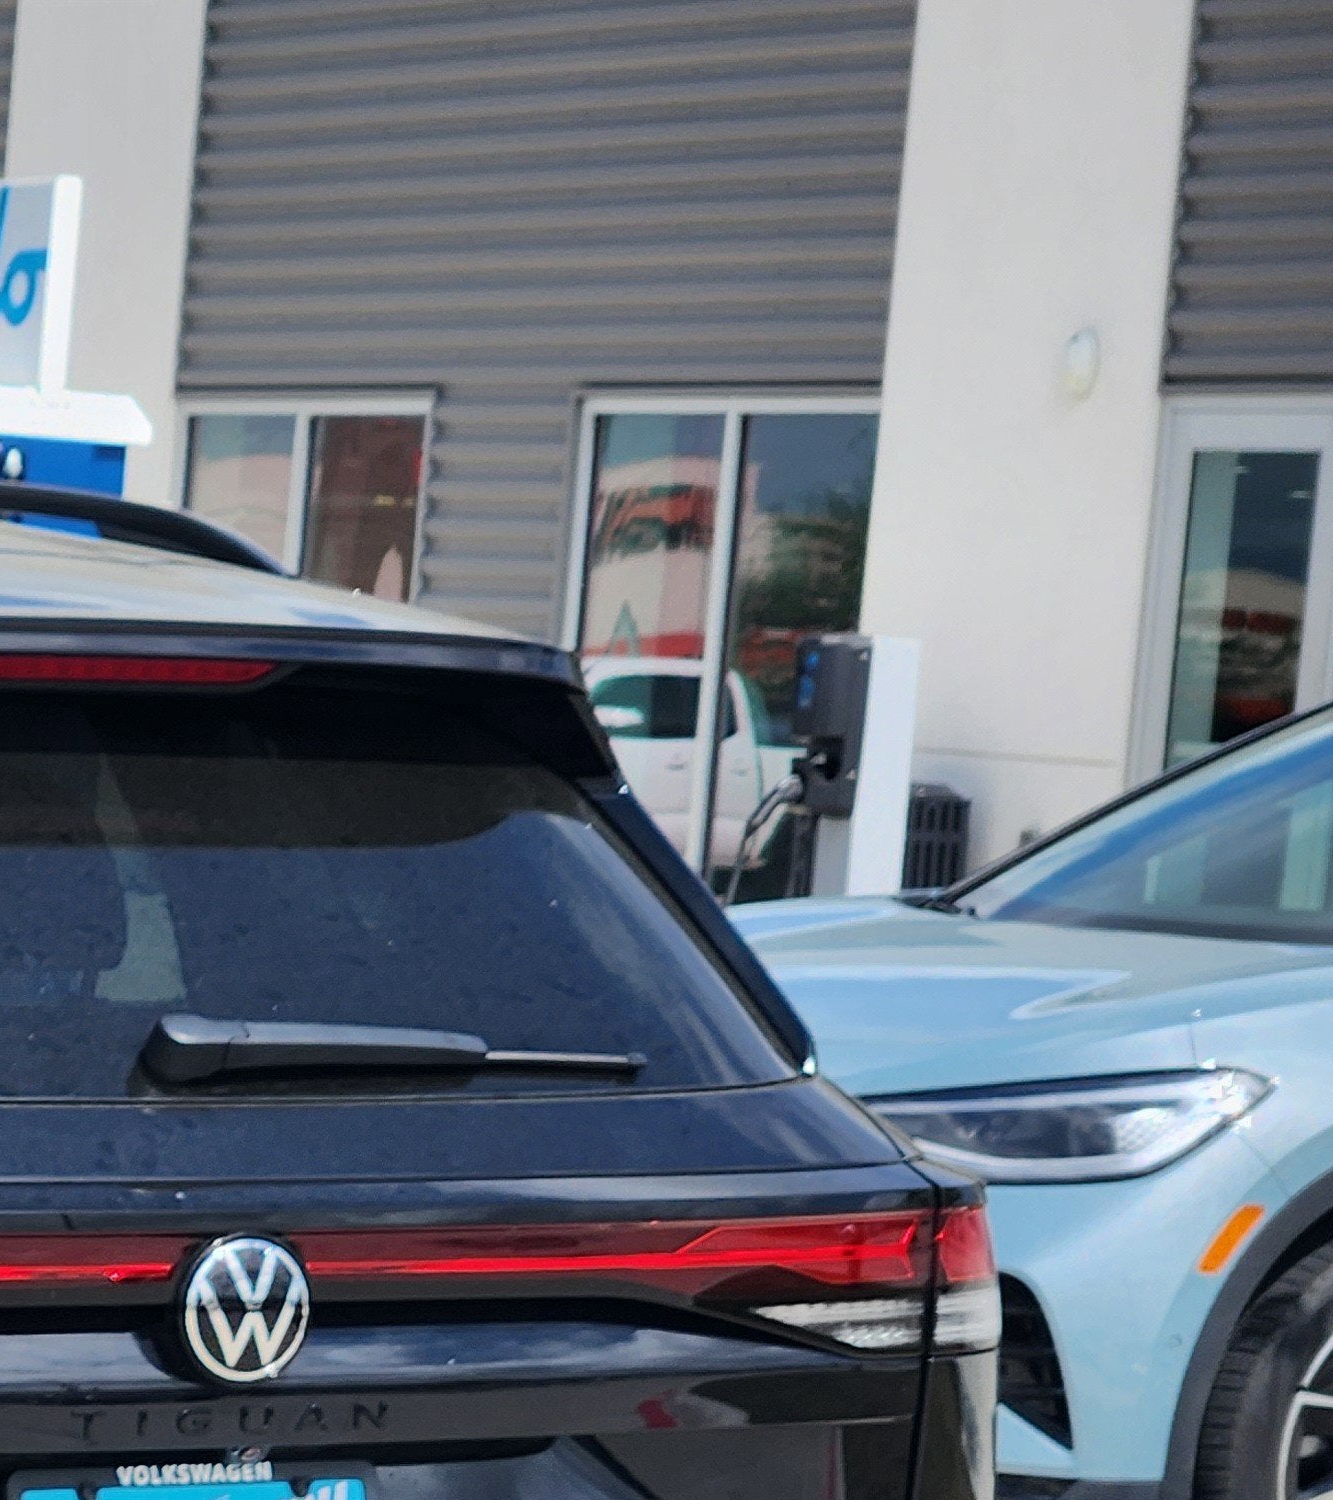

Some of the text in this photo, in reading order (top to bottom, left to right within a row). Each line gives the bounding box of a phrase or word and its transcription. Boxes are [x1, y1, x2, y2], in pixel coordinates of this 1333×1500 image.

[185, 1237, 310, 1382] VW
[71, 1401, 389, 1439] TIGUAN
[116, 1461, 273, 1486] VOLKSWAGEN
